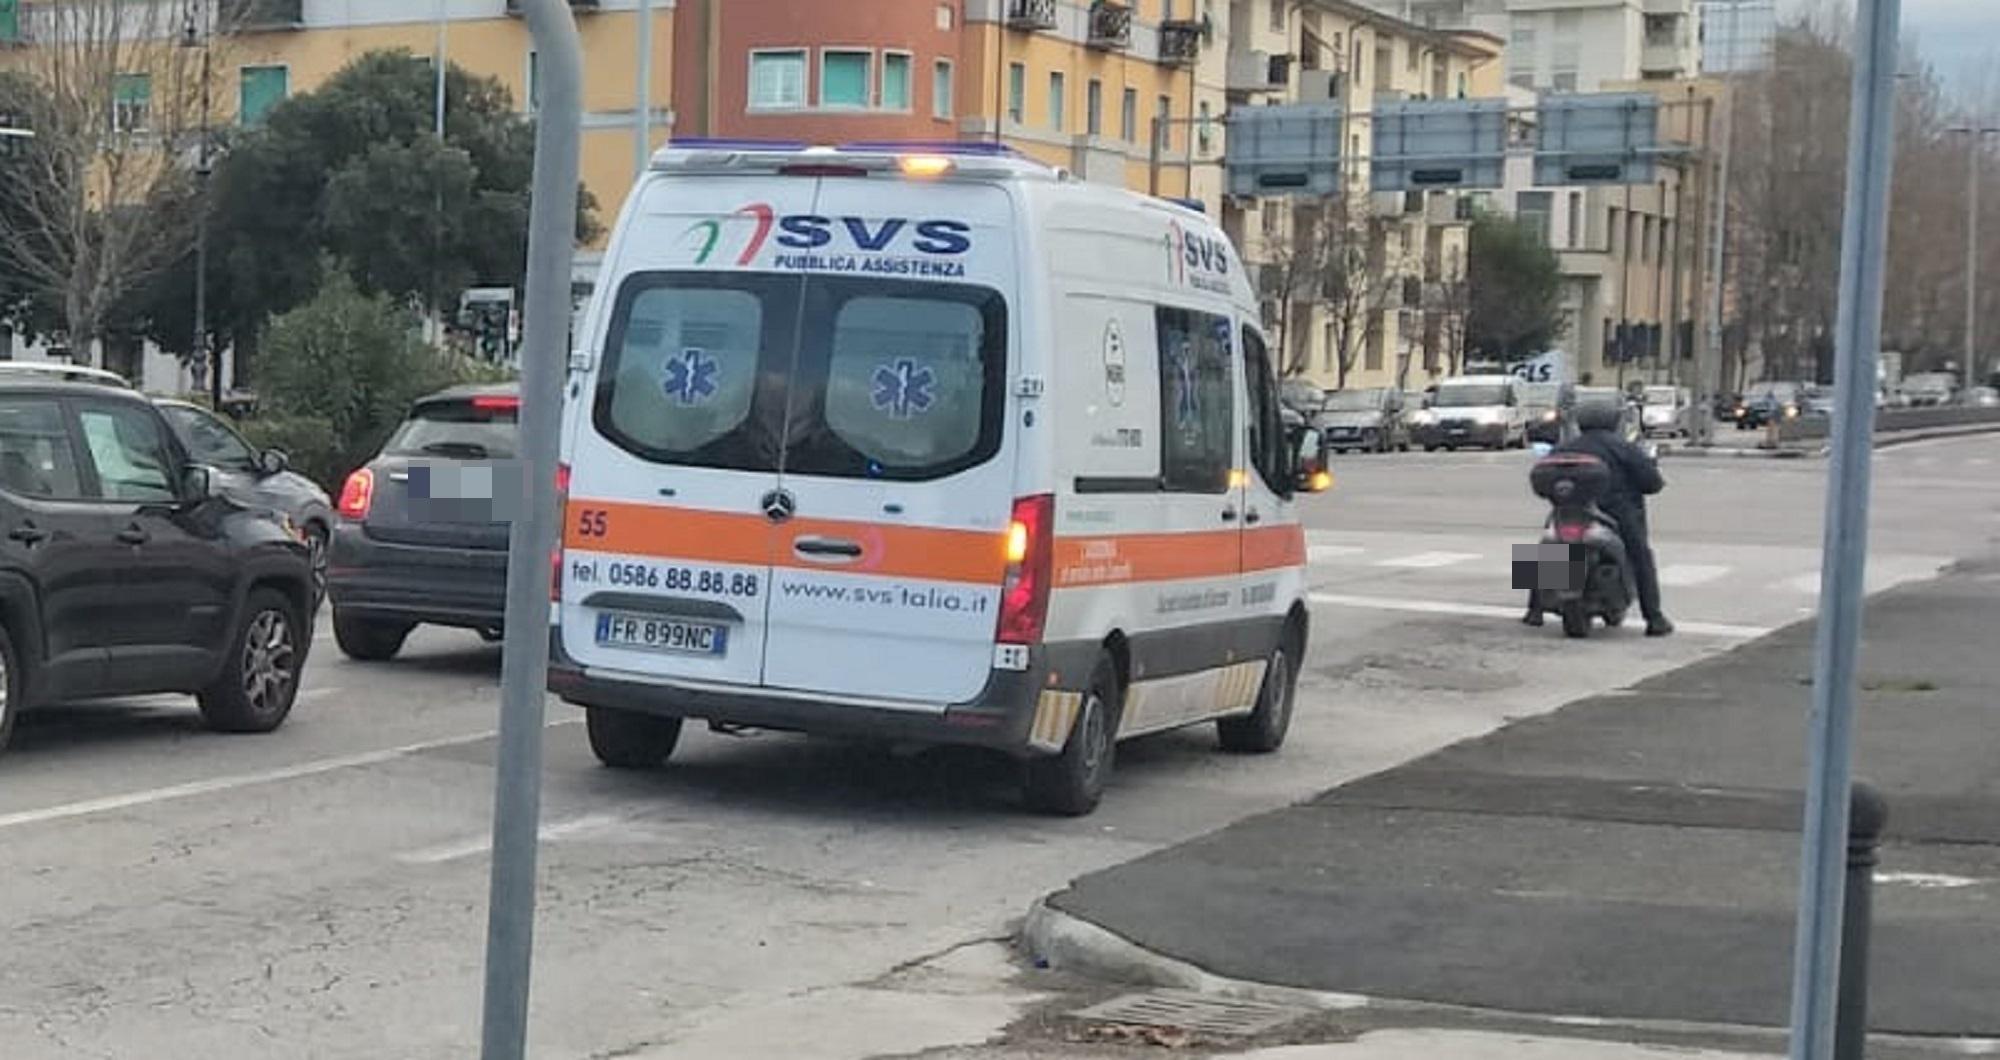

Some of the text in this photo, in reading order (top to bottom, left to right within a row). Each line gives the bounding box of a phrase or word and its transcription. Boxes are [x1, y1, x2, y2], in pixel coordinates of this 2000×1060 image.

[776, 213, 971, 255] SVS
[774, 254, 966, 277] PUBBLICA ASSISTENZA
[1184, 230, 1228, 274] SVS
[1511, 363, 1552, 382] GLS
[578, 509, 607, 537] 55
[571, 559, 758, 597] tel. 0586 88.88.88
[782, 580, 987, 613] www.svstalia.it
[611, 617, 713, 649] FR 899NC
